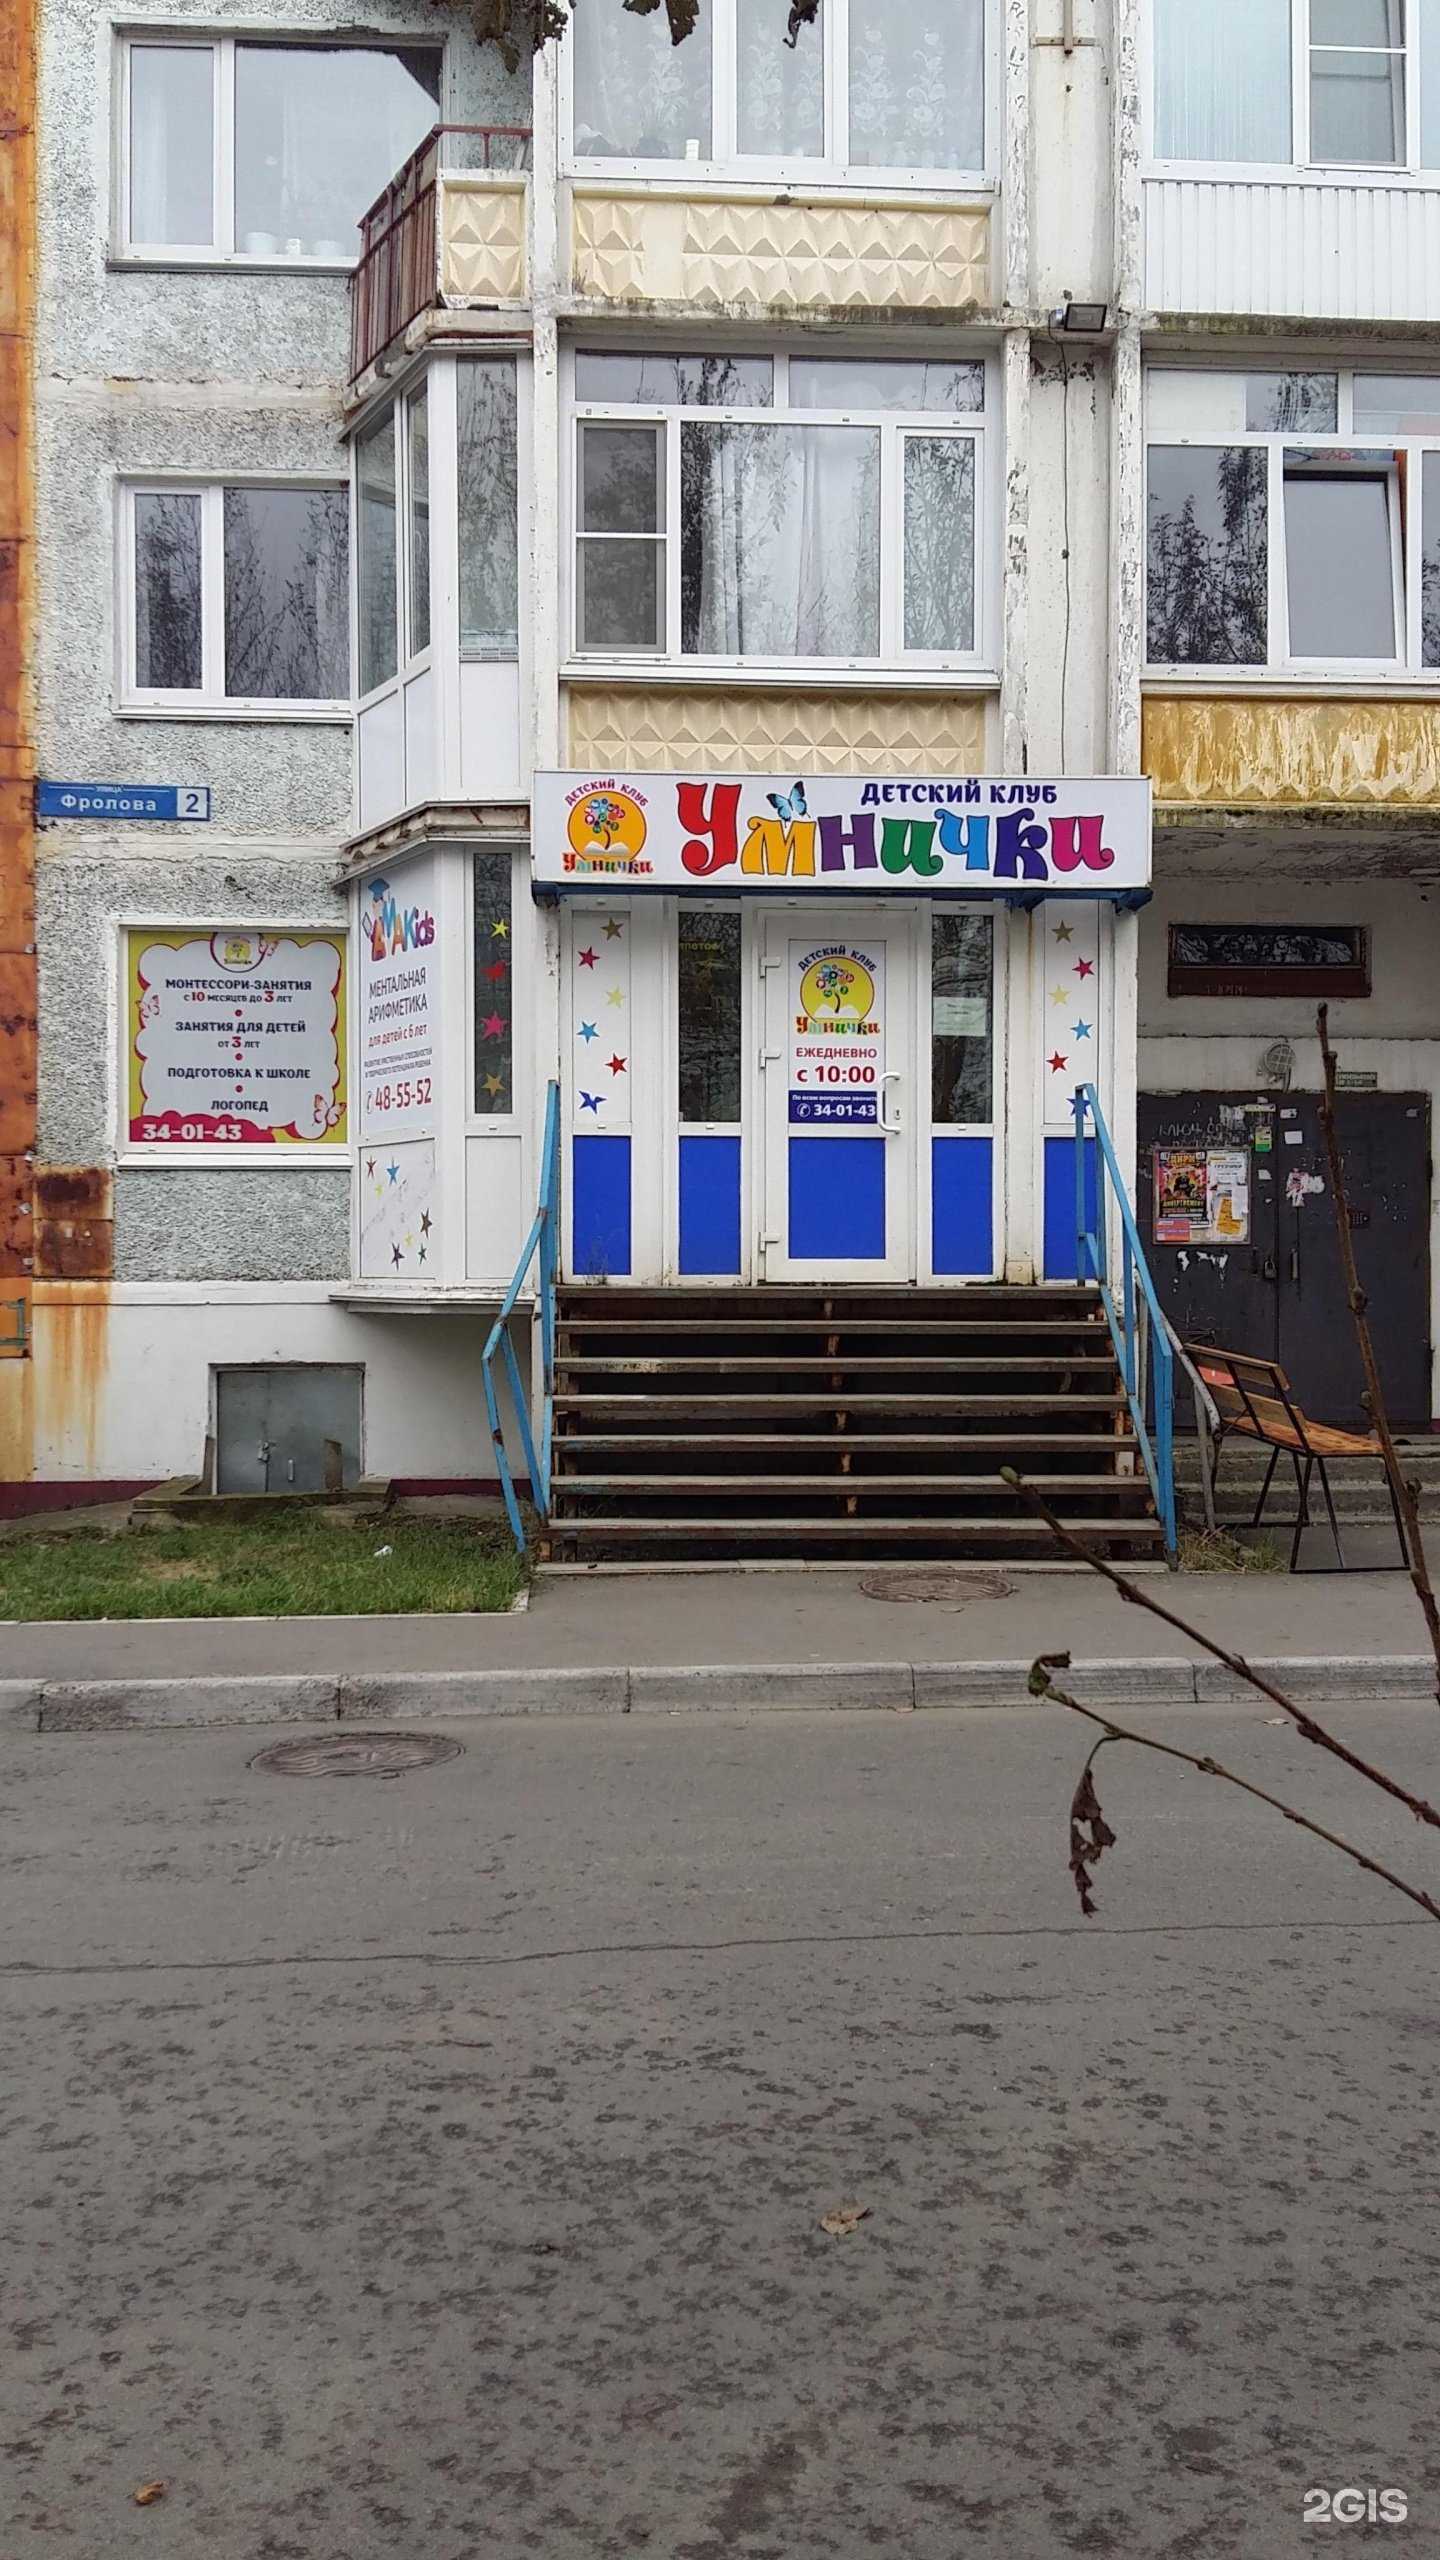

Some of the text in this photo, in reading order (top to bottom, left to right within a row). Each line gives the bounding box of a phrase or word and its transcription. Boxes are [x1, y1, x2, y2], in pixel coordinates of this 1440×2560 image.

[564, 778, 649, 807] ДЕТСКИЙ КЛУБ
[860, 779, 1058, 806] ДЕТСКИЙ КЛУБ
[60, 793, 199, 813] Фролова 2
[798, 945, 877, 973] ДЕТСКИЙ КЛУБ
[165, 979, 312, 991] МОНТЕССОРИ-ЗАНЯТИЯ
[368, 966, 426, 1000] МЕНТАЛЬНАЯ
[191, 991, 206, 1002] 10
[264, 990, 274, 1003] 3
[368, 993, 428, 1024] АРИФМЕТИКА
[175, 1020, 306, 1034] ЗАНЯТИЯ ДЛЯ ДЕТЕЙ
[403, 1028, 408, 1039] с
[409, 1024, 414, 1038] 6
[231, 1036, 242, 1049] 3
[796, 1047, 878, 1060] ЕЖЕДНЕВНО
[167, 1067, 312, 1080] ПОДГОТОВКА К ШКОЛЕ
[814, 1065, 876, 1084] 10:00
[375, 1078, 432, 1111] 48-55-52
[210, 1100, 269, 1113] ЛОГОПЕД
[813, 1103, 877, 1117] 34-01-43
[142, 1123, 243, 1141] 34-01-43
